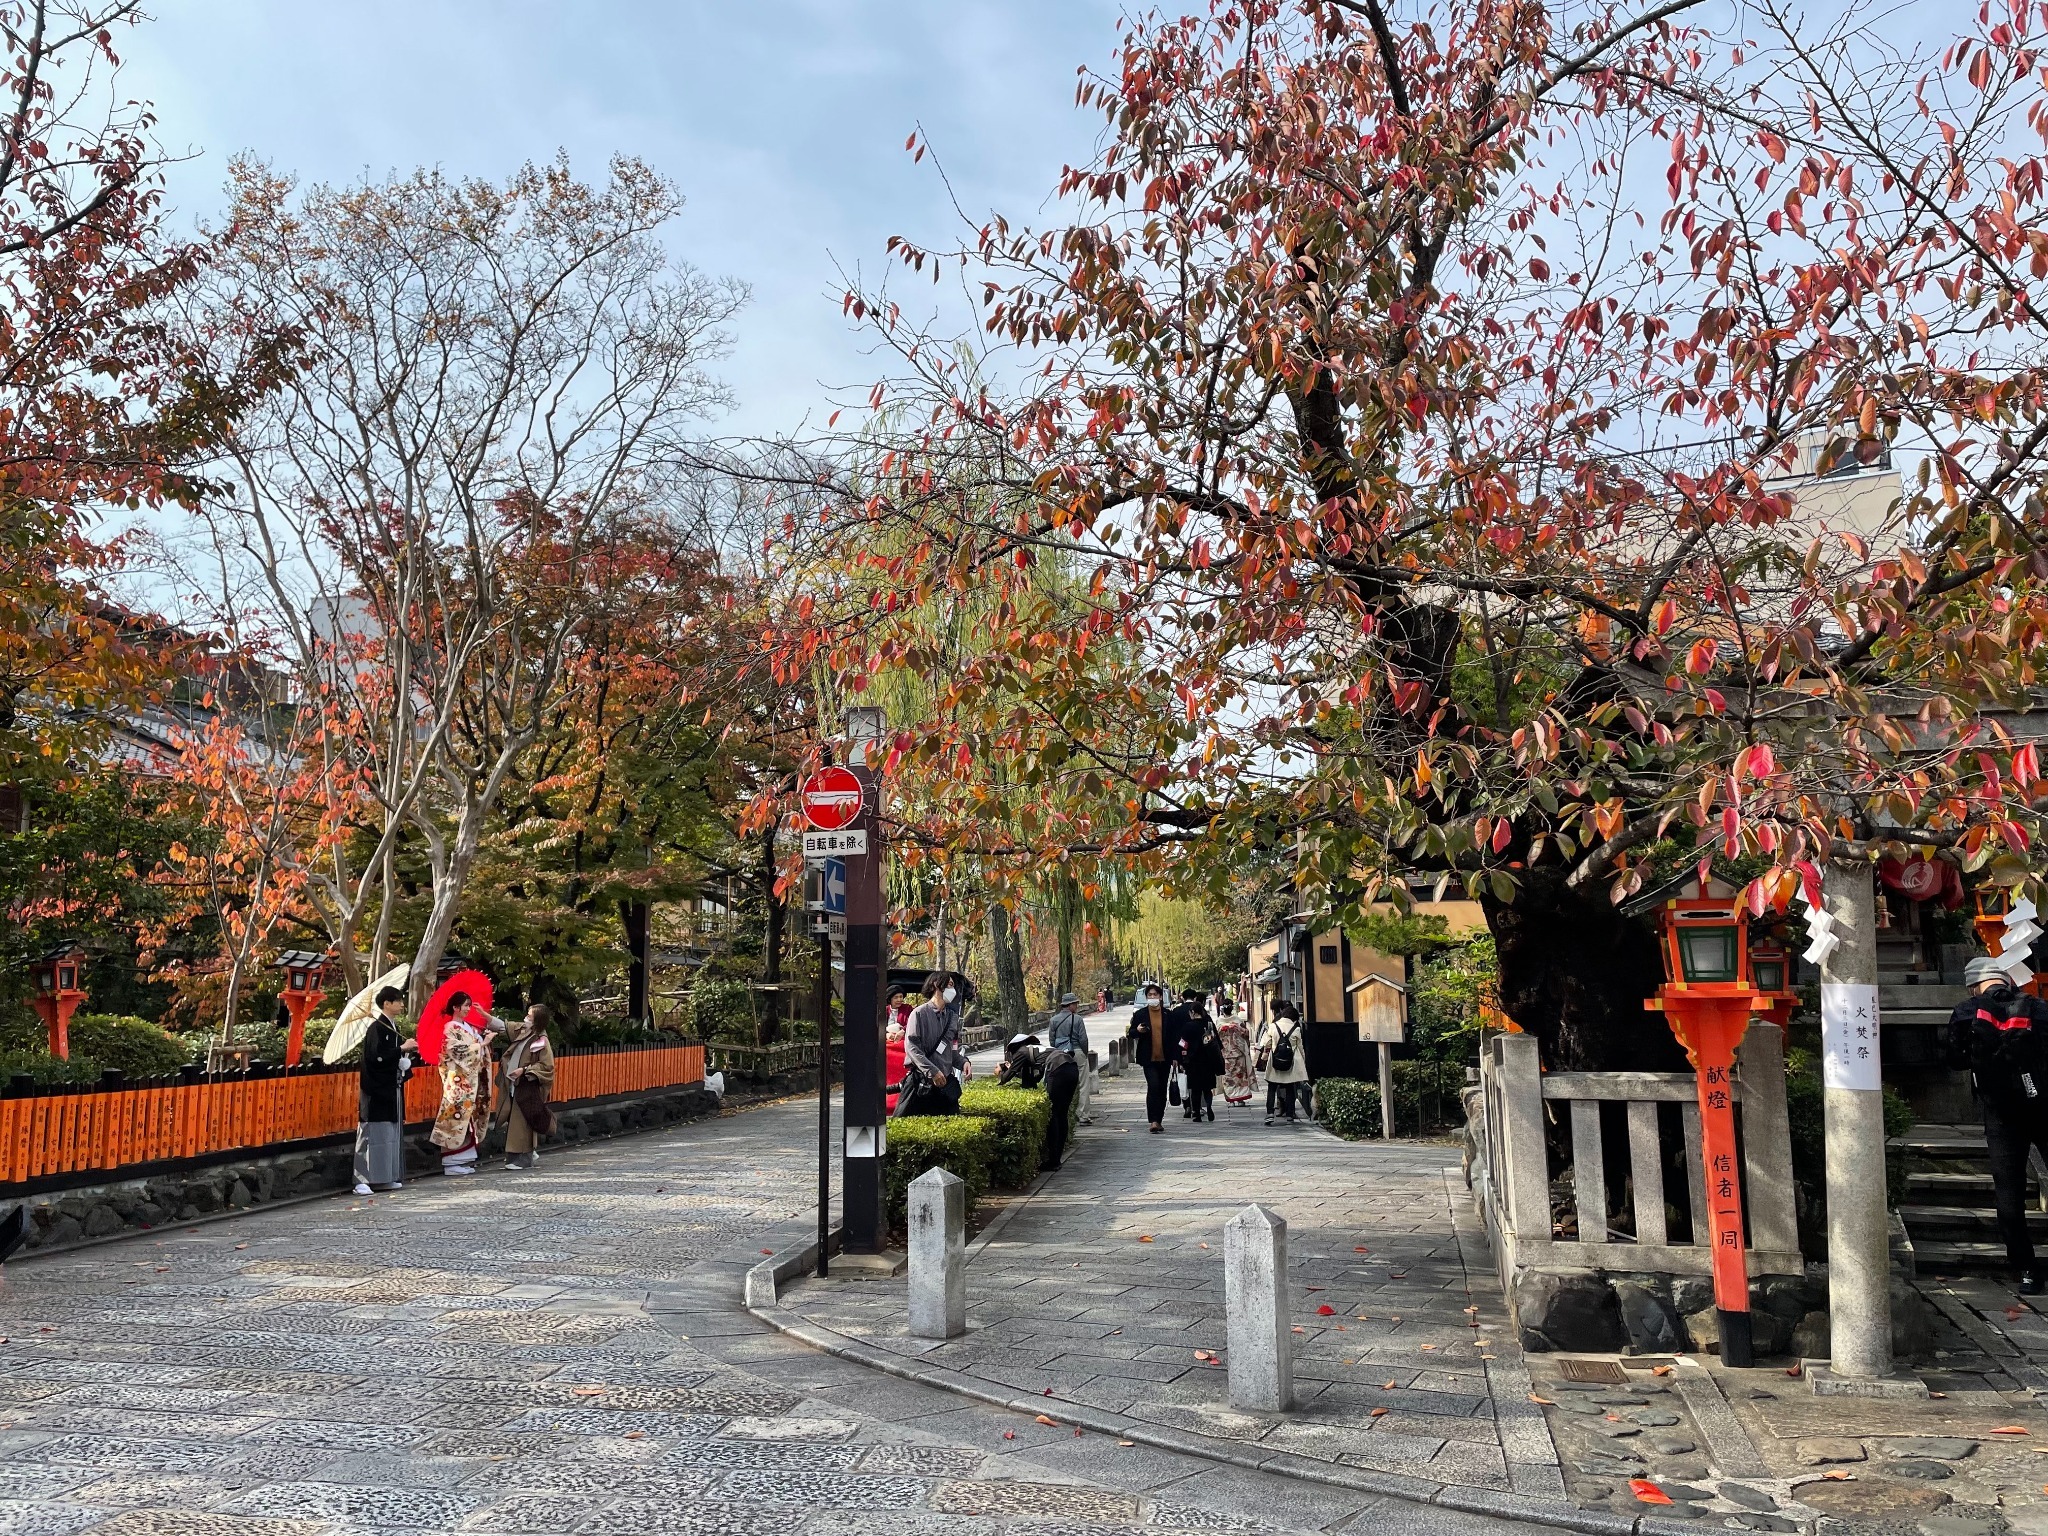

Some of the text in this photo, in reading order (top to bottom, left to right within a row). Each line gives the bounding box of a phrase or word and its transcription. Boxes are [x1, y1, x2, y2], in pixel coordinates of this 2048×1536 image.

[806, 836, 864, 851] 自転車を除く
[1856, 1006, 1869, 1059] 火焚祭
[1707, 1066, 1738, 1250] 献燈 信者一同
